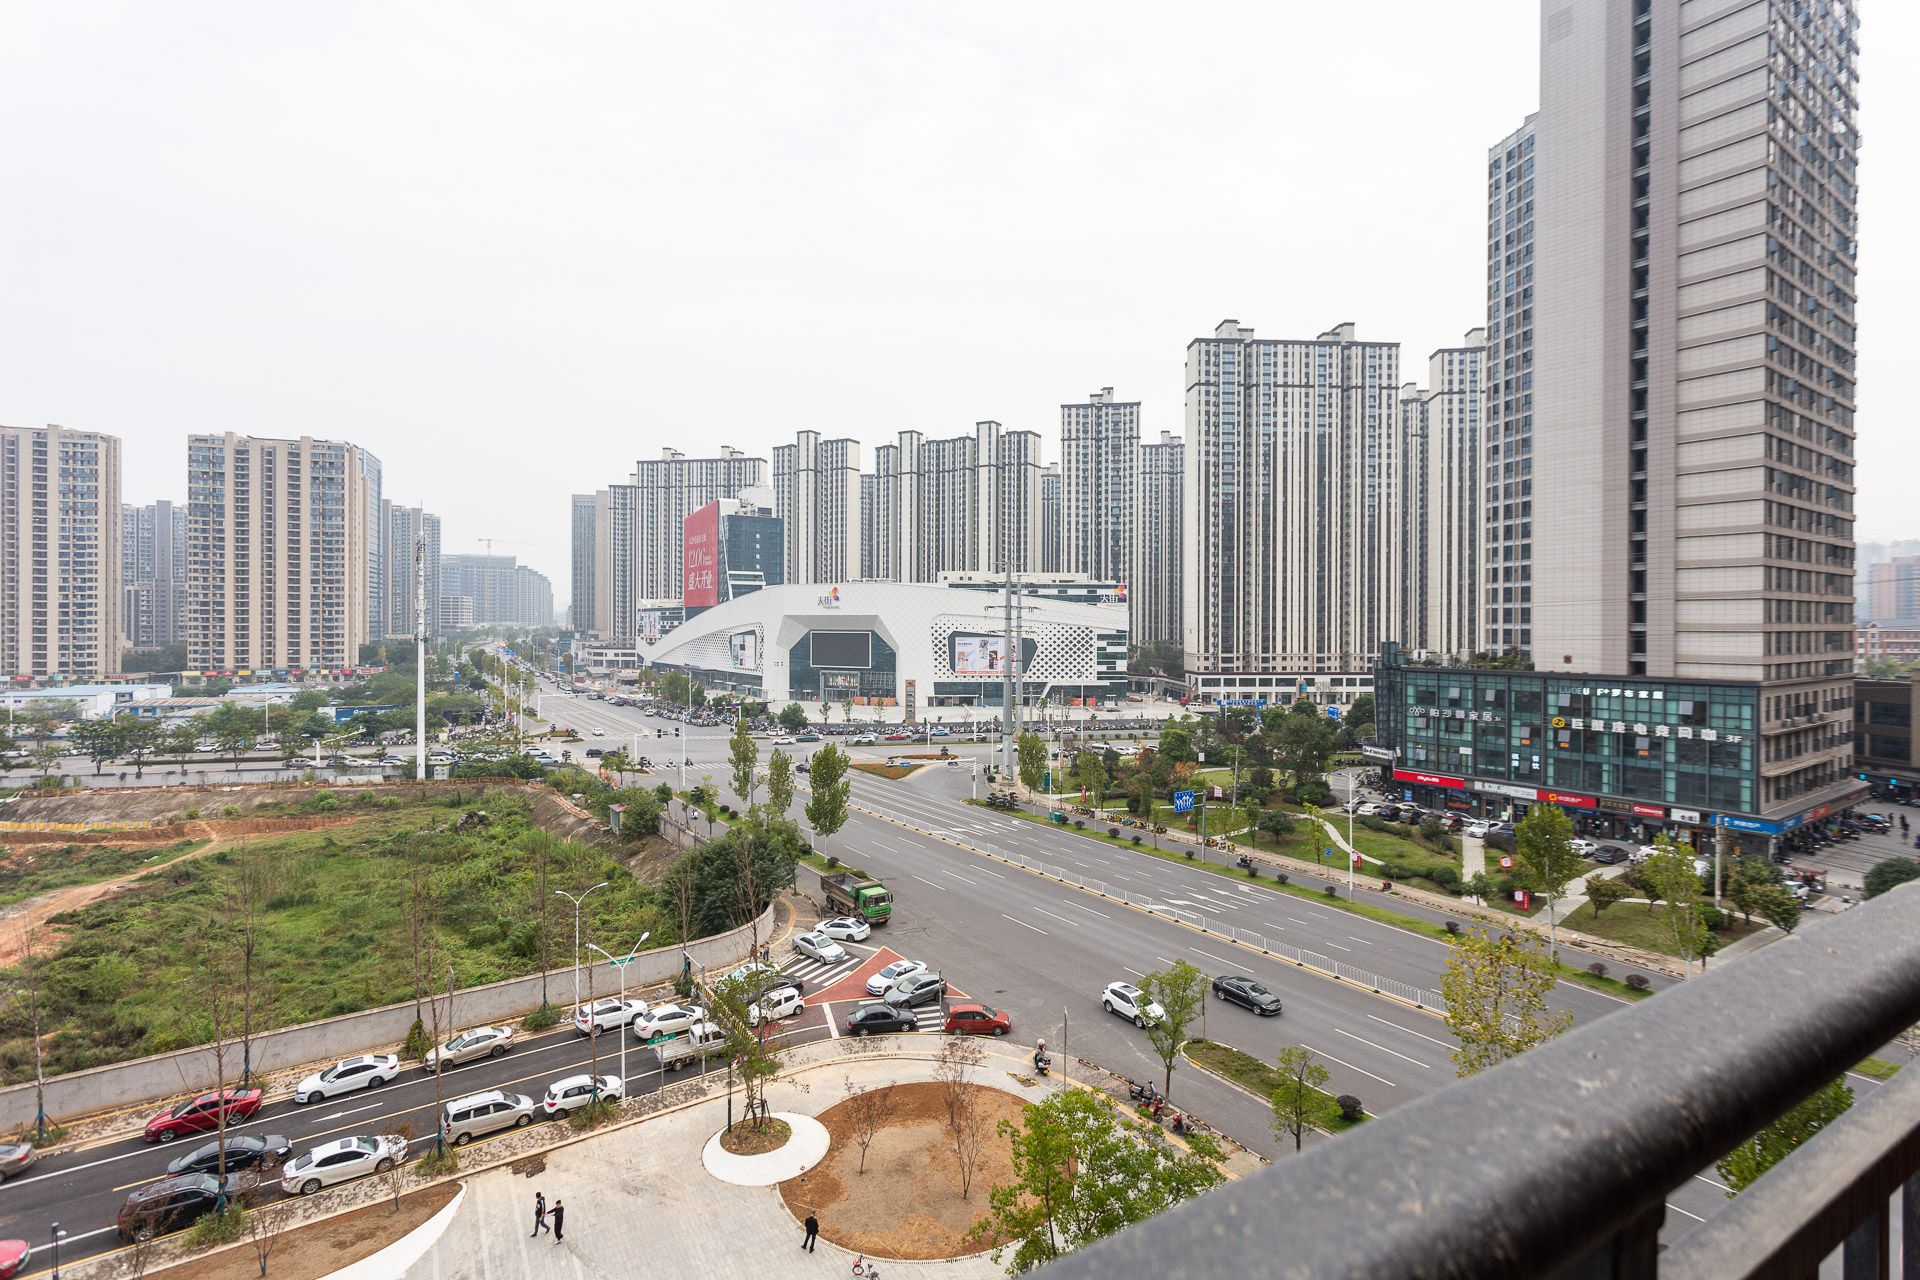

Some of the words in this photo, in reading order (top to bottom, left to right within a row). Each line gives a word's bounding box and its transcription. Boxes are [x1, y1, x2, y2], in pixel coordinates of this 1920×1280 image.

[687, 569, 712, 591] 盛大开业
[1100, 594, 1119, 603] 天街
[1725, 735, 1743, 743] 3F
